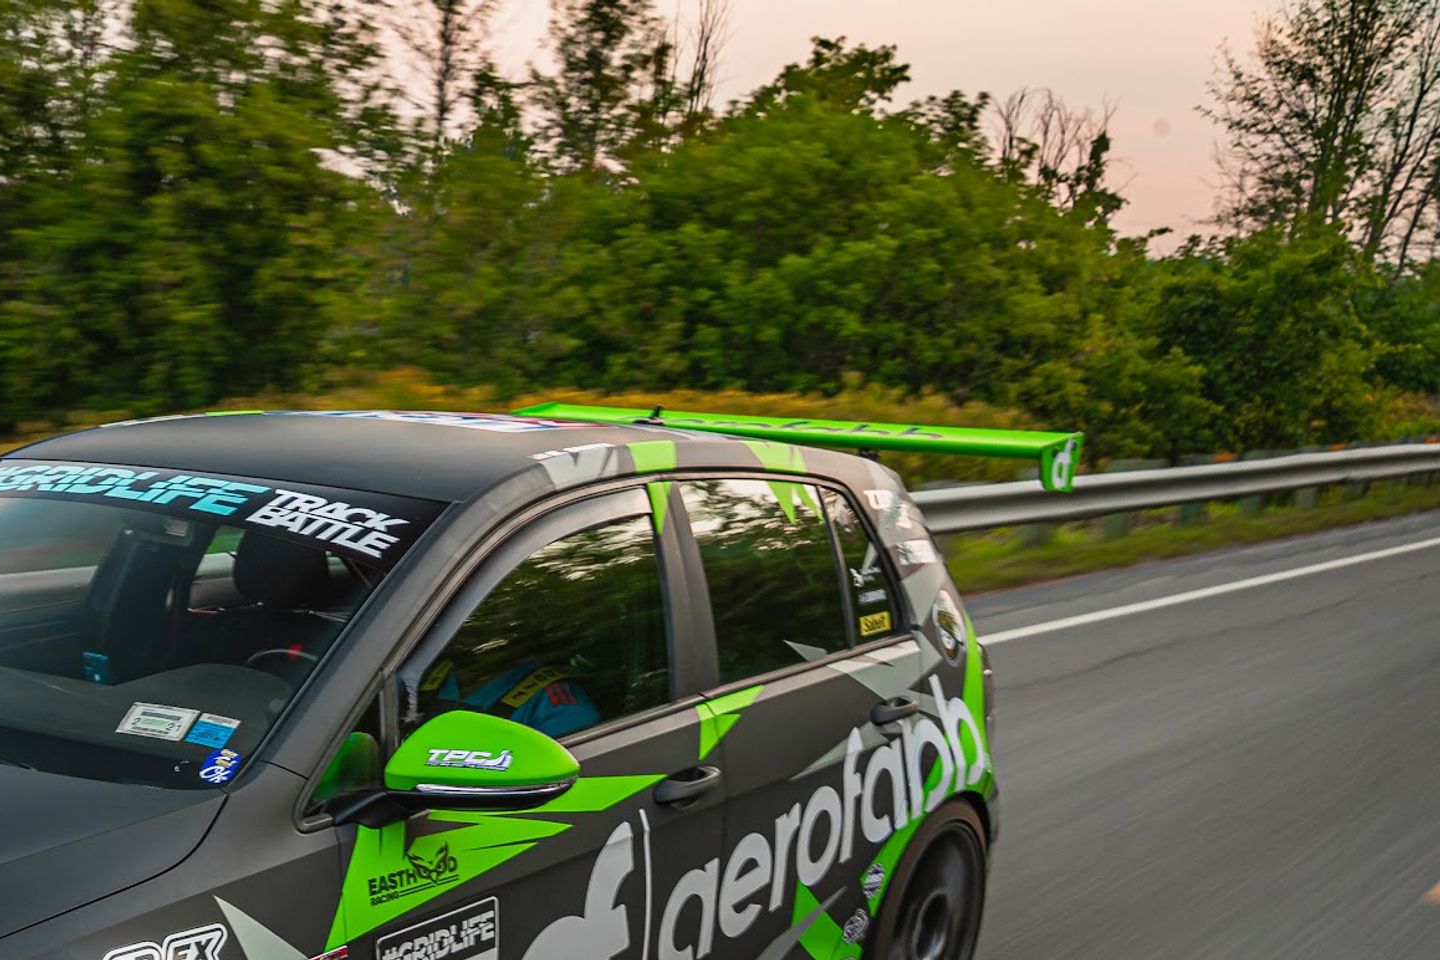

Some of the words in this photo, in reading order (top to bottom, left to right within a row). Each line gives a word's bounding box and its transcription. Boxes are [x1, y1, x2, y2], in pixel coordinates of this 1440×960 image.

[272, 489, 410, 532] TRACK
[246, 507, 401, 559] BATTLE
[370, 891, 400, 906] RACING
